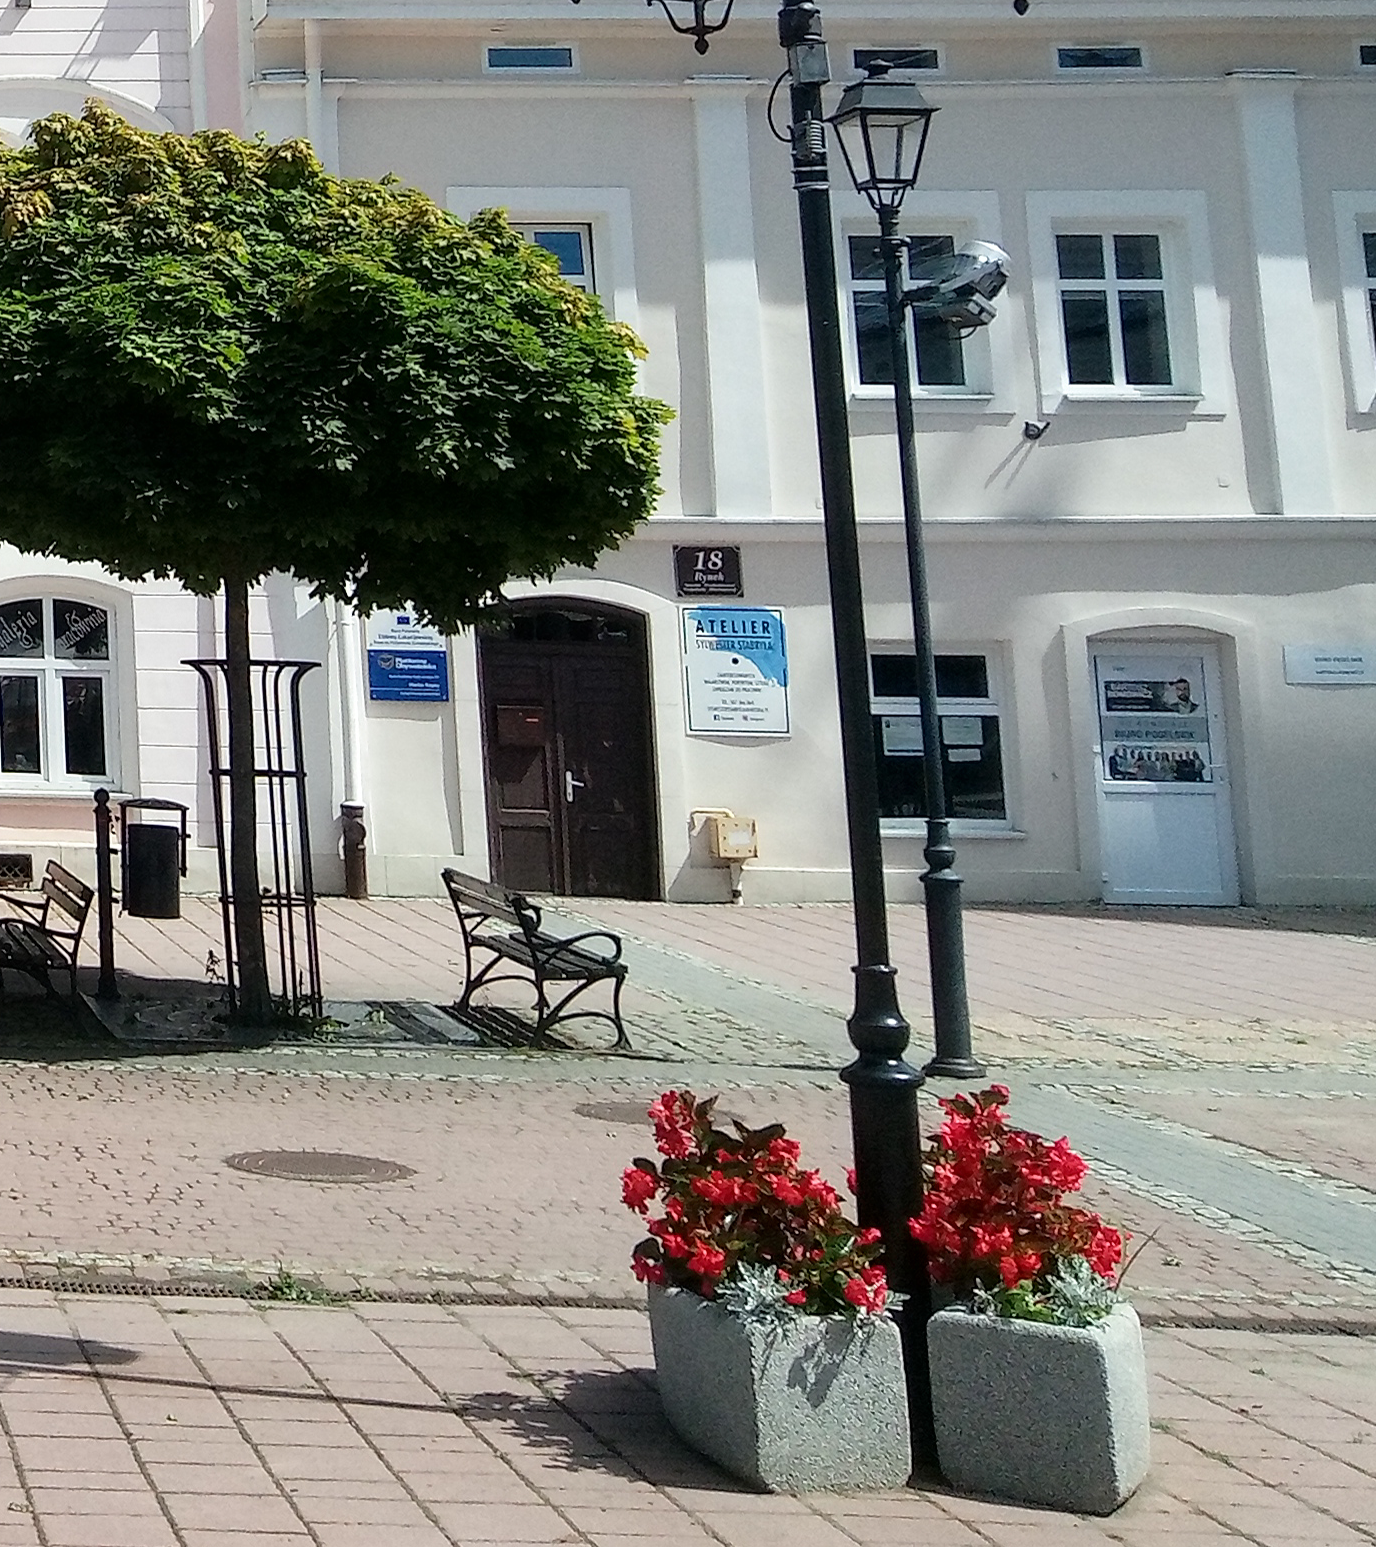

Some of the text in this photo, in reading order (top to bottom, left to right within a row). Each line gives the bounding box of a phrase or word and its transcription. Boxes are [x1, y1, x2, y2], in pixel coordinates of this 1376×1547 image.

[693, 550, 723, 570] 18
[694, 572, 724, 584] Rynek
[696, 619, 771, 634] ATELIER
